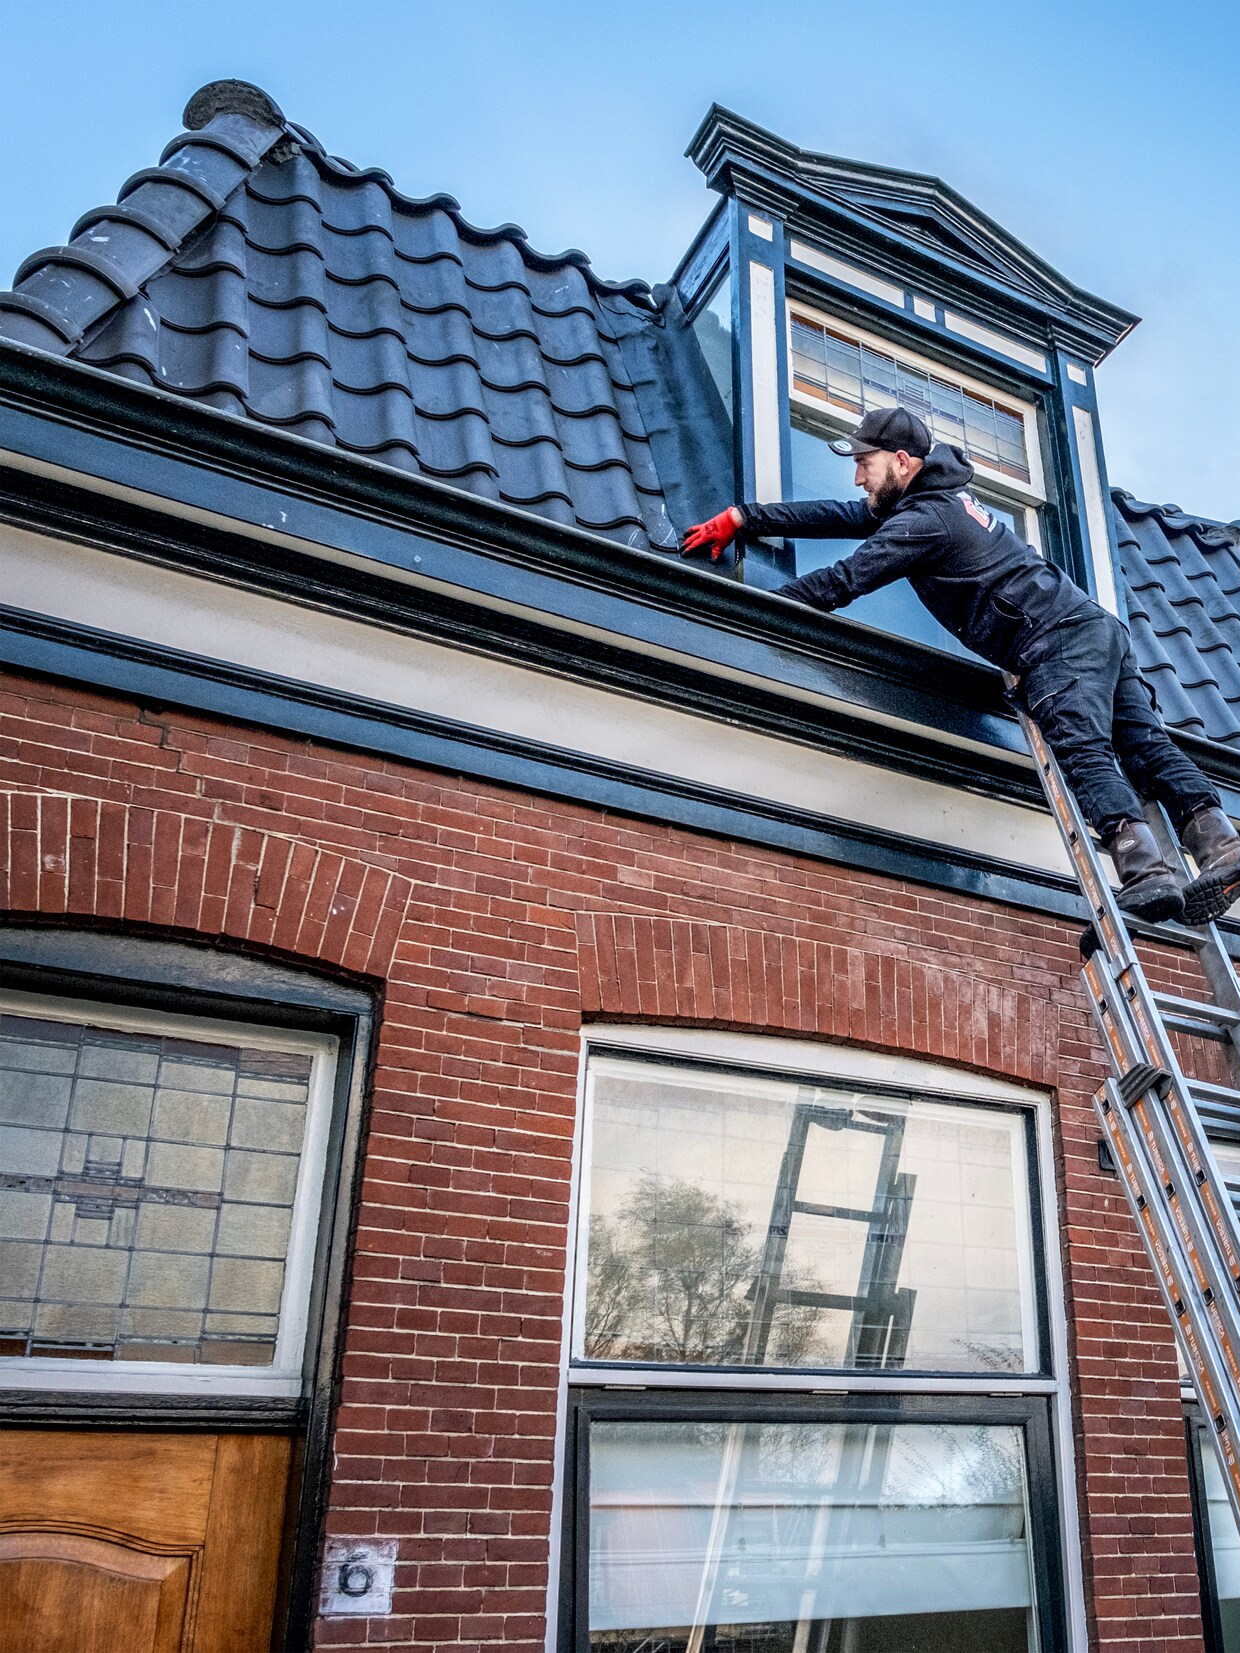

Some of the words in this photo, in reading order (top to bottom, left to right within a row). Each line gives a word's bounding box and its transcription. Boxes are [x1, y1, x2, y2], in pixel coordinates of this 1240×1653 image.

[1151, 1141, 1164, 1174] TUBESCA
[1175, 1206, 1189, 1241] TUBESCA
[1215, 1220, 1231, 1256] TUBESCA
[1189, 1336, 1204, 1374] TUBESCA
